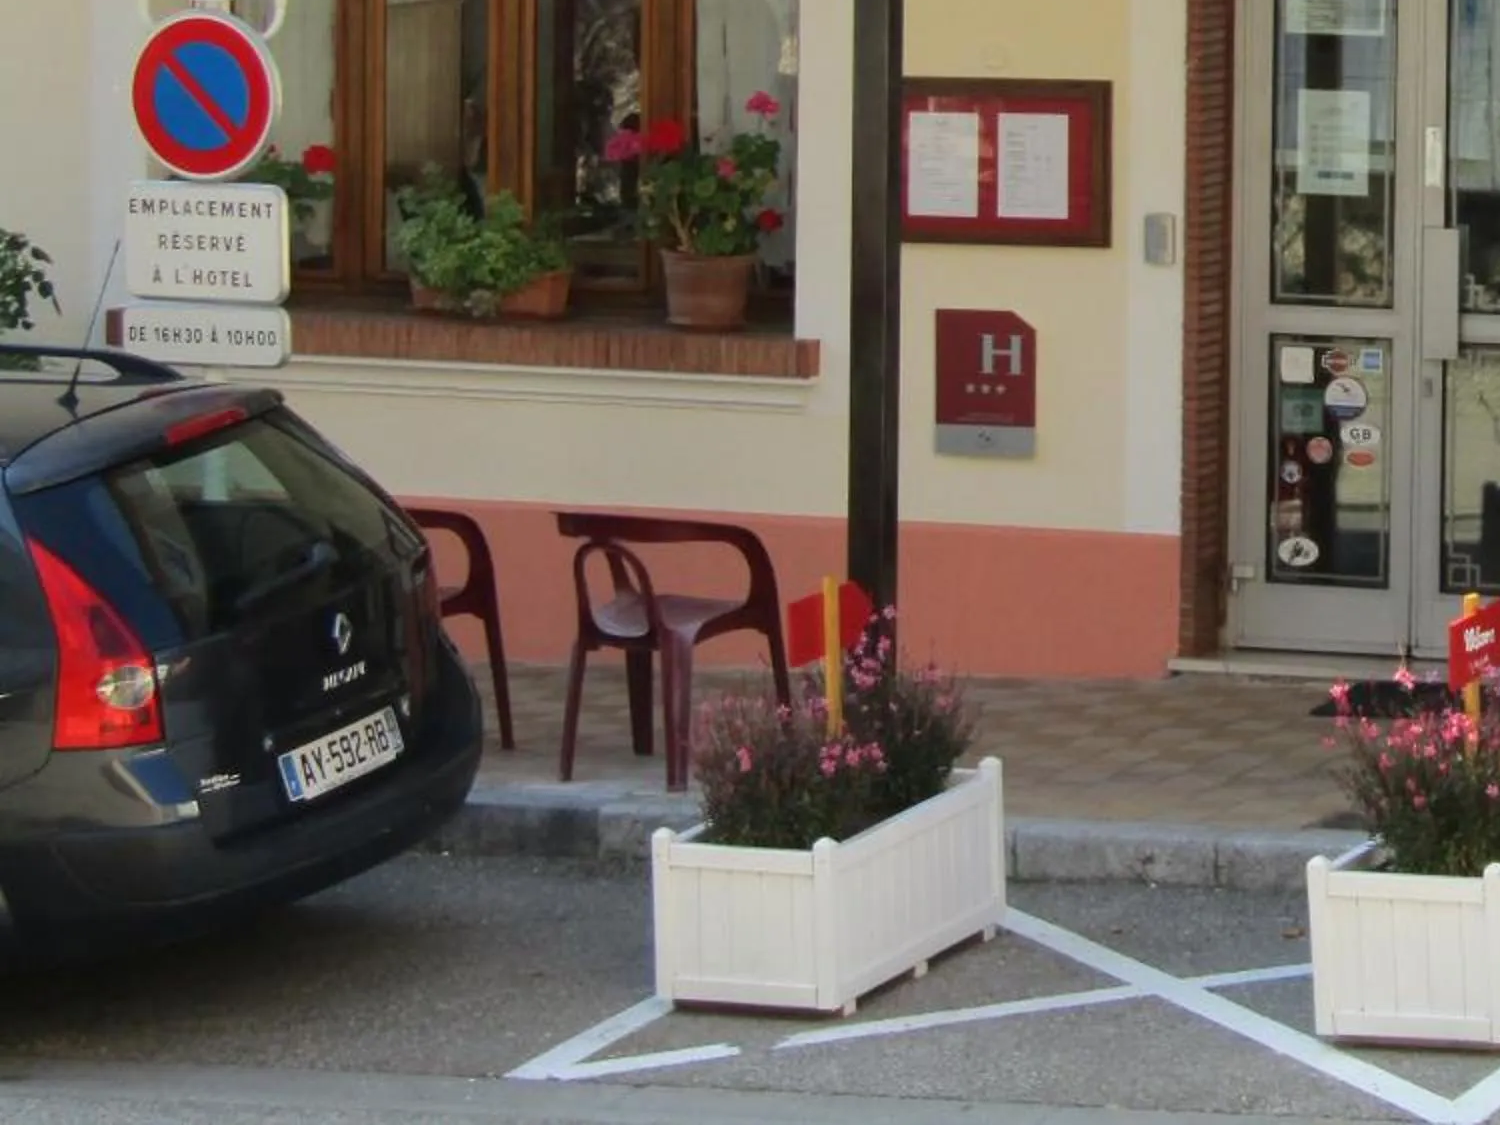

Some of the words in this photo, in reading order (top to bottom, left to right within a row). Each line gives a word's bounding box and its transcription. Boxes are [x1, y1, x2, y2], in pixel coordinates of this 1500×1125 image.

[128, 197, 273, 219] EMPLACEMENT
[128, 326, 147, 342] DE
[154, 327, 203, 345] 16H30
[227, 329, 278, 347] 10H00
[979, 333, 1023, 376] H
